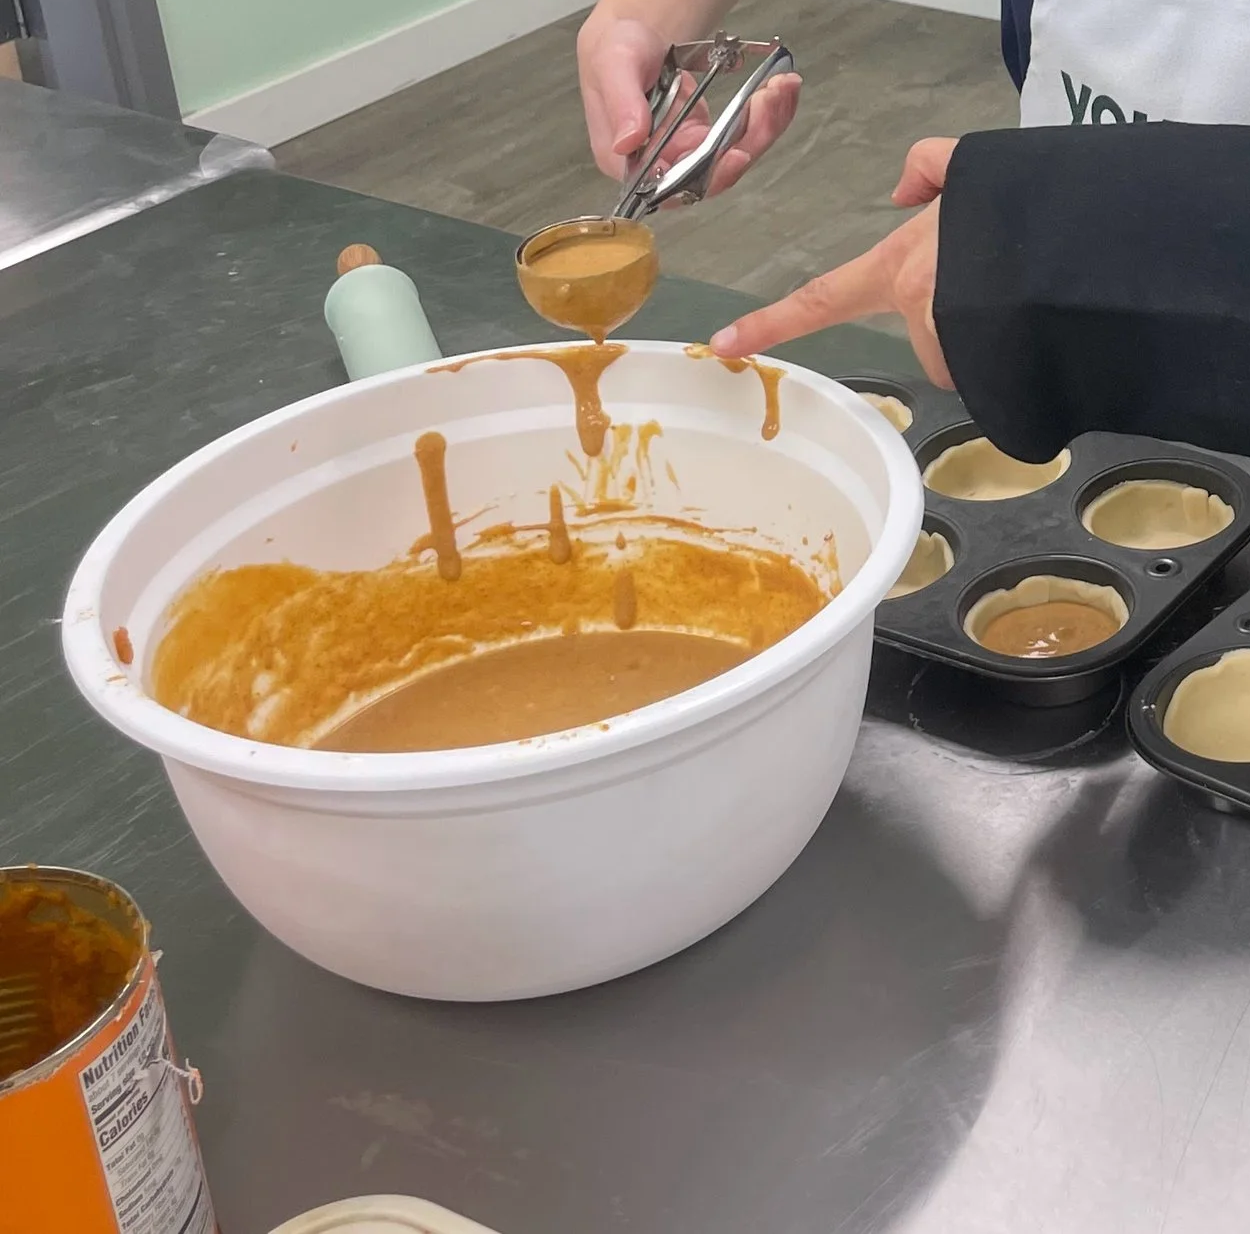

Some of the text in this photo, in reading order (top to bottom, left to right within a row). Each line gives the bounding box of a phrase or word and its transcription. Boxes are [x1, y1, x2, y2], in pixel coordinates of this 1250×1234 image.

[83, 1022, 140, 1089] Nutrition
[91, 1085, 123, 1115] Serving
[99, 1090, 148, 1147] Calories
[125, 1141, 136, 1155] Fat
